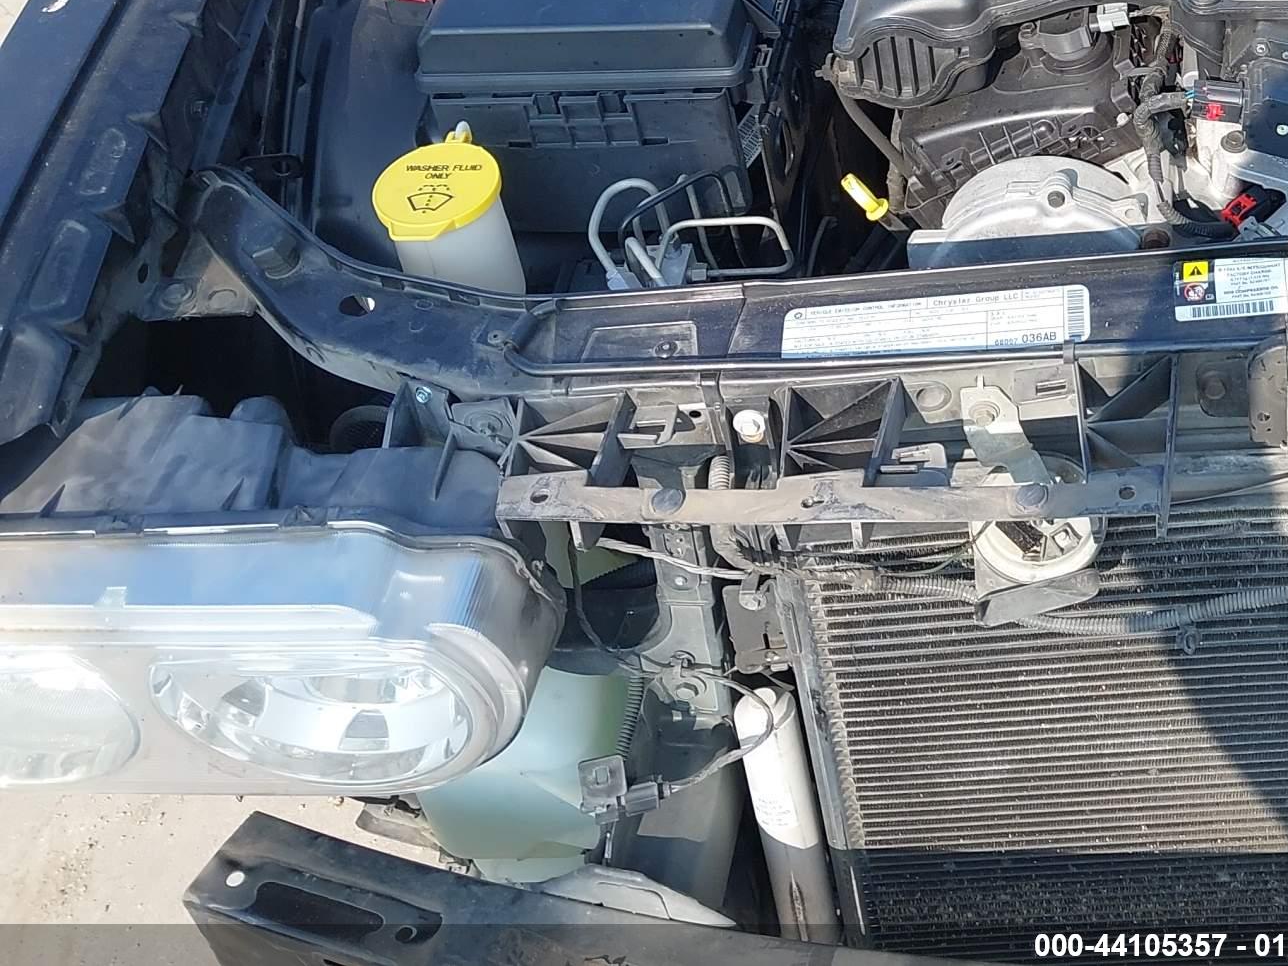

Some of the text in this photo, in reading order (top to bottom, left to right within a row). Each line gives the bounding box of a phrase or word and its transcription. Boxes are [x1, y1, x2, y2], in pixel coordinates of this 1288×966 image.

[406, 164, 483, 172] WASHER FLUID
[424, 172, 452, 180] ONLY
[933, 298, 971, 307] Chrysler
[976, 295, 999, 304] Group
[1003, 292, 1019, 300] LLC
[1021, 331, 1058, 344] 036AB
